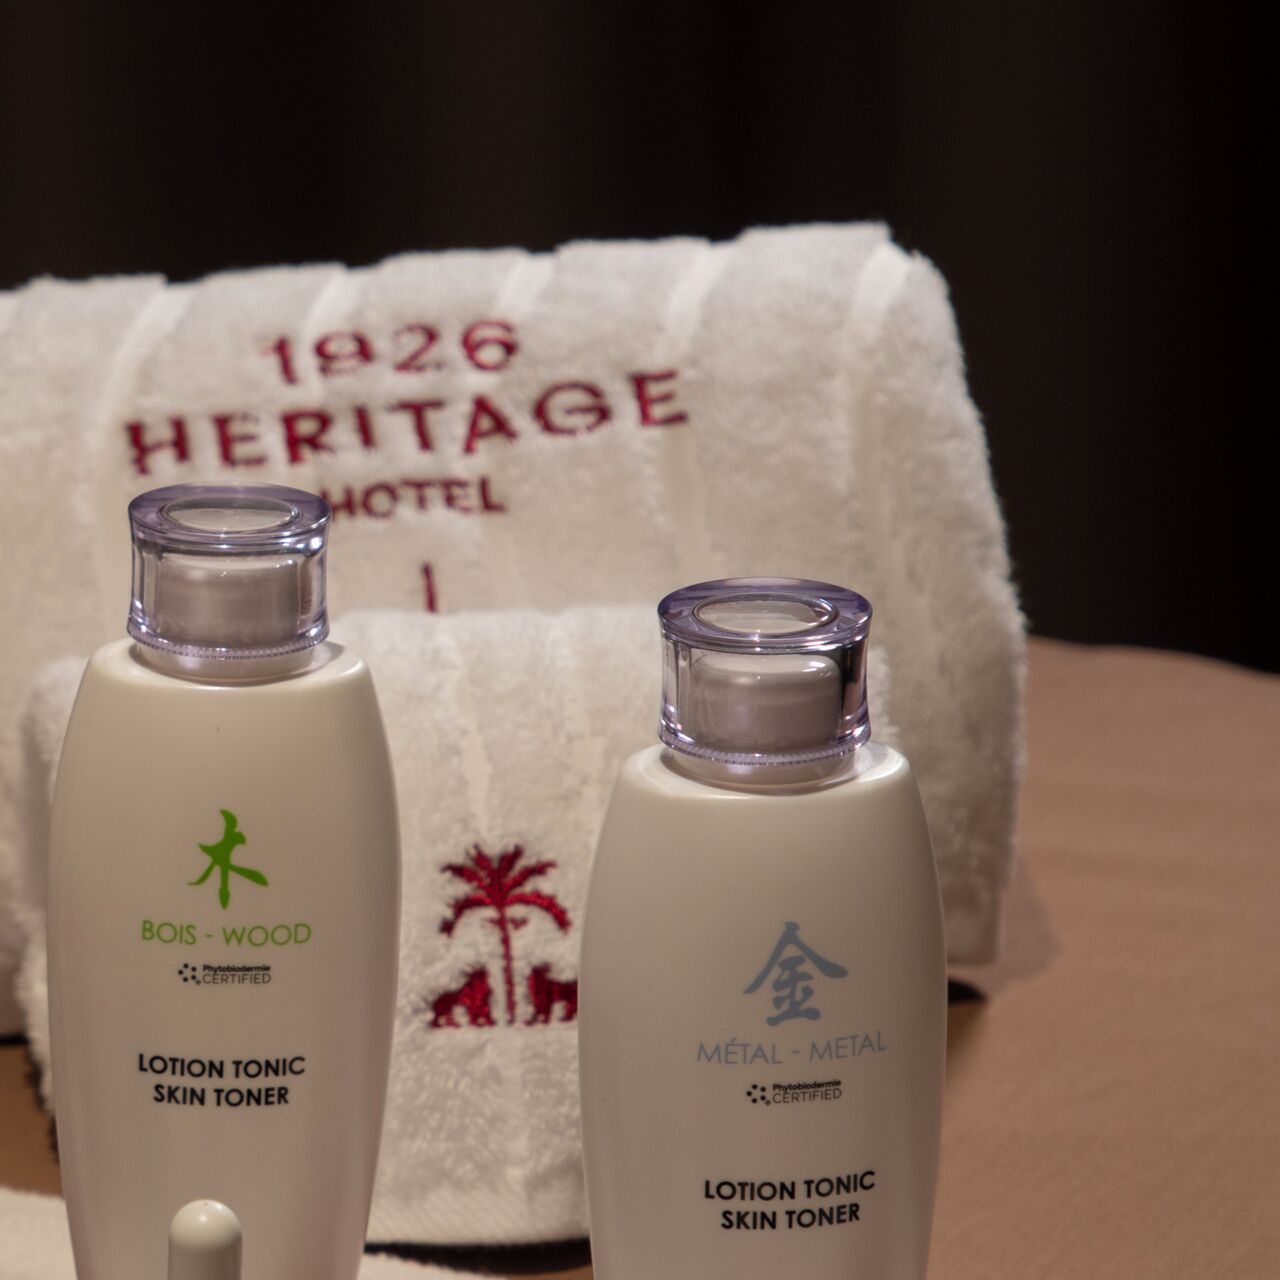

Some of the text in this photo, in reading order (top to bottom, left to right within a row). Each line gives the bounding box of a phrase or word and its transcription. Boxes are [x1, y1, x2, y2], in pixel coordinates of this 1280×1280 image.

[264, 321, 522, 385] 1926
[126, 370, 690, 475] HERITAGE
[328, 476, 508, 520] HOTEL
[141, 920, 197, 946] BOIS
[221, 922, 312, 948] WOOD
[202, 972, 272, 985] CERTIFIED
[742, 921, 849, 1027] 金
[696, 1036, 783, 1065] MÉTAL
[808, 1030, 888, 1063] METAL
[138, 1053, 306, 1079] LOTION TONIC
[153, 1084, 289, 1107] SKIN TONER
[772, 1079, 842, 1094] Phytobiodermie
[772, 1087, 842, 1104] CERTIFIED
[704, 1170, 875, 1201] LOTION TONIC
[721, 1203, 861, 1230] SKIN TONER
